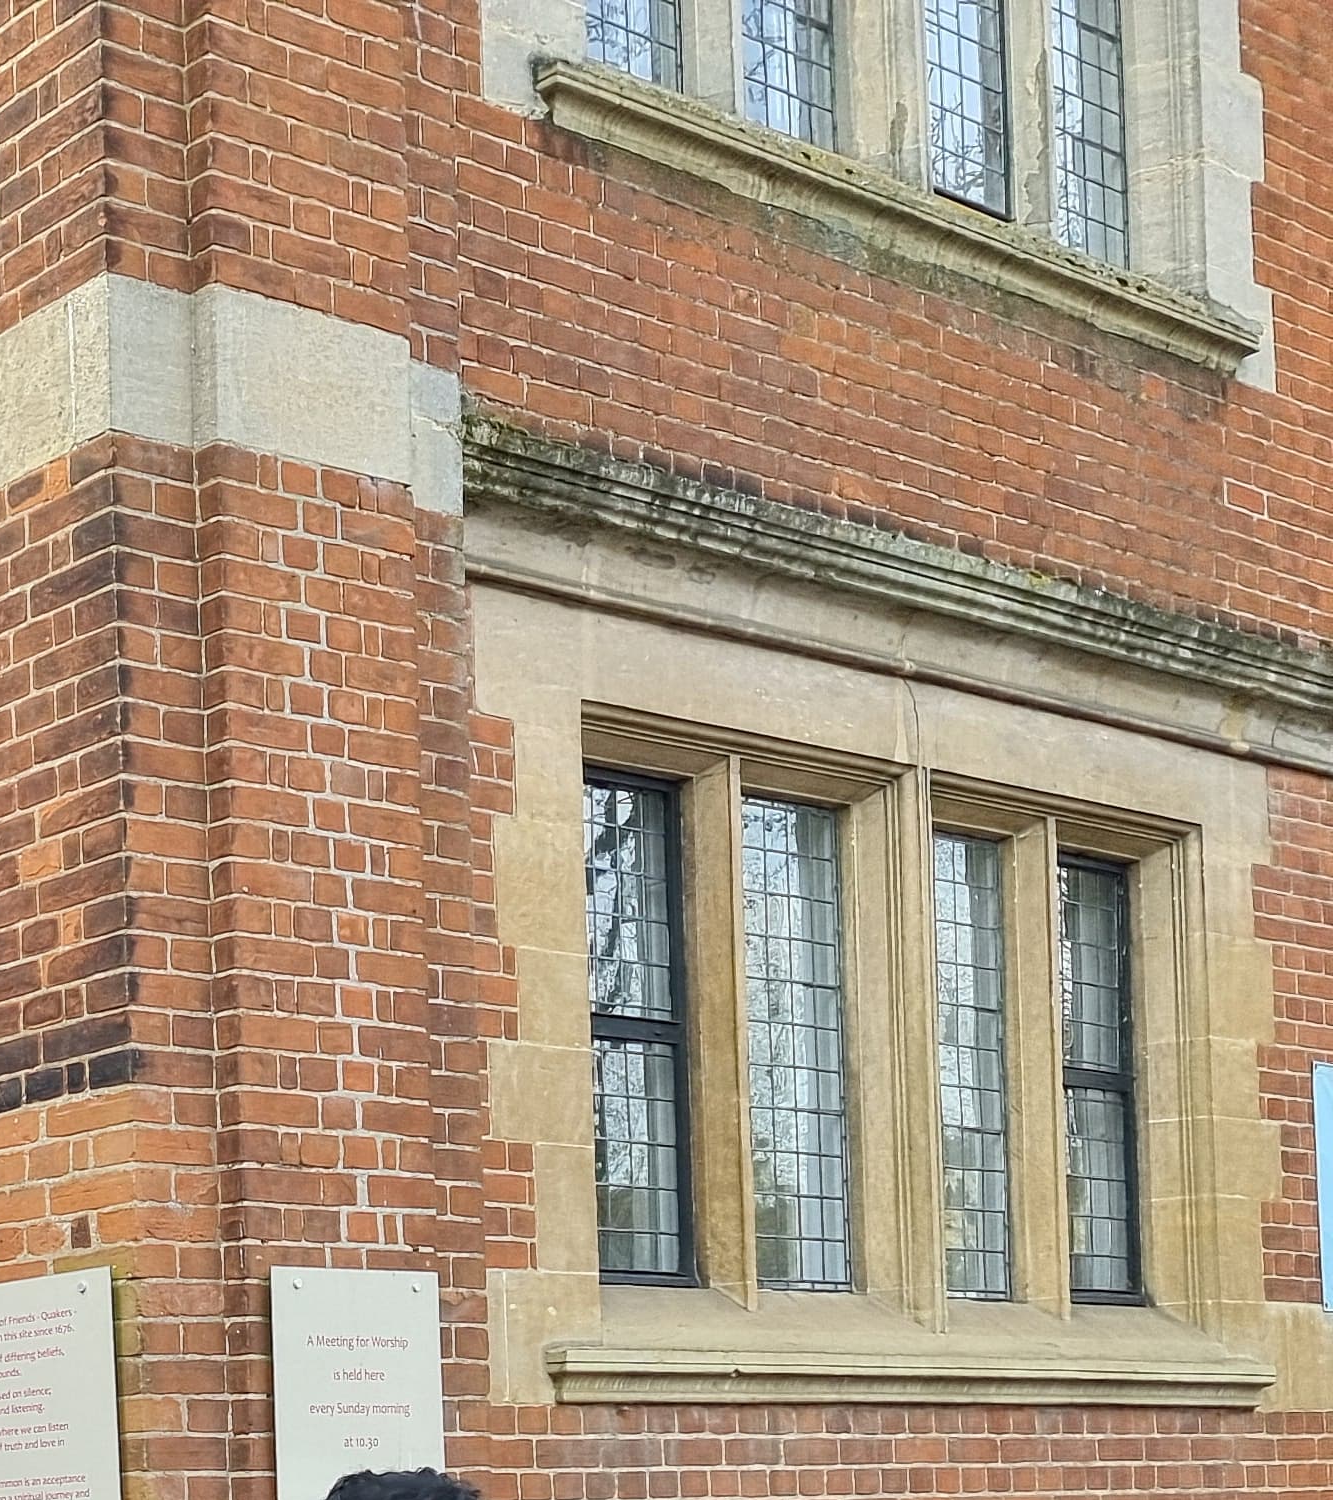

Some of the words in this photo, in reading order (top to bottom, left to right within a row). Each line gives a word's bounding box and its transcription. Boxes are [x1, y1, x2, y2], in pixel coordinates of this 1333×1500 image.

[0, 1317, 7, 1327] of
[9, 1313, 35, 1325] Friends
[41, 1309, 72, 1322] Quakers
[4, 1330, 17, 1341] this
[19, 1328, 32, 1339] site
[34, 1326, 53, 1337] since
[55, 1324, 75, 1335] 1676.
[307, 1336, 314, 1346] A
[316, 1336, 353, 1351] Meeting
[356, 1336, 369, 1347] for
[372, 1336, 408, 1350] Worship
[4, 1351, 36, 1363] differing
[38, 1346, 65, 1358] beliefs,
[333, 1370, 340, 1380] is
[342, 1368, 362, 1380] held
[365, 1369, 385, 1381] here
[12, 1390, 22, 1399] on
[11, 1402, 45, 1415] listening.
[309, 1404, 335, 1417] every
[337, 1403, 370, 1416] Sunday
[373, 1404, 410, 1417] morning
[34, 1426, 46, 1434] can
[48, 1422, 68, 1432] listen
[5, 1440, 22, 1450] truth
[25, 1438, 39, 1449] and
[40, 1438, 56, 1448] love
[58, 1438, 65, 1447] in
[344, 1437, 353, 1447] at
[356, 1438, 379, 1450] 10.30
[43, 1474, 85, 1487] acceptance
[76, 1488, 90, 1498] and
